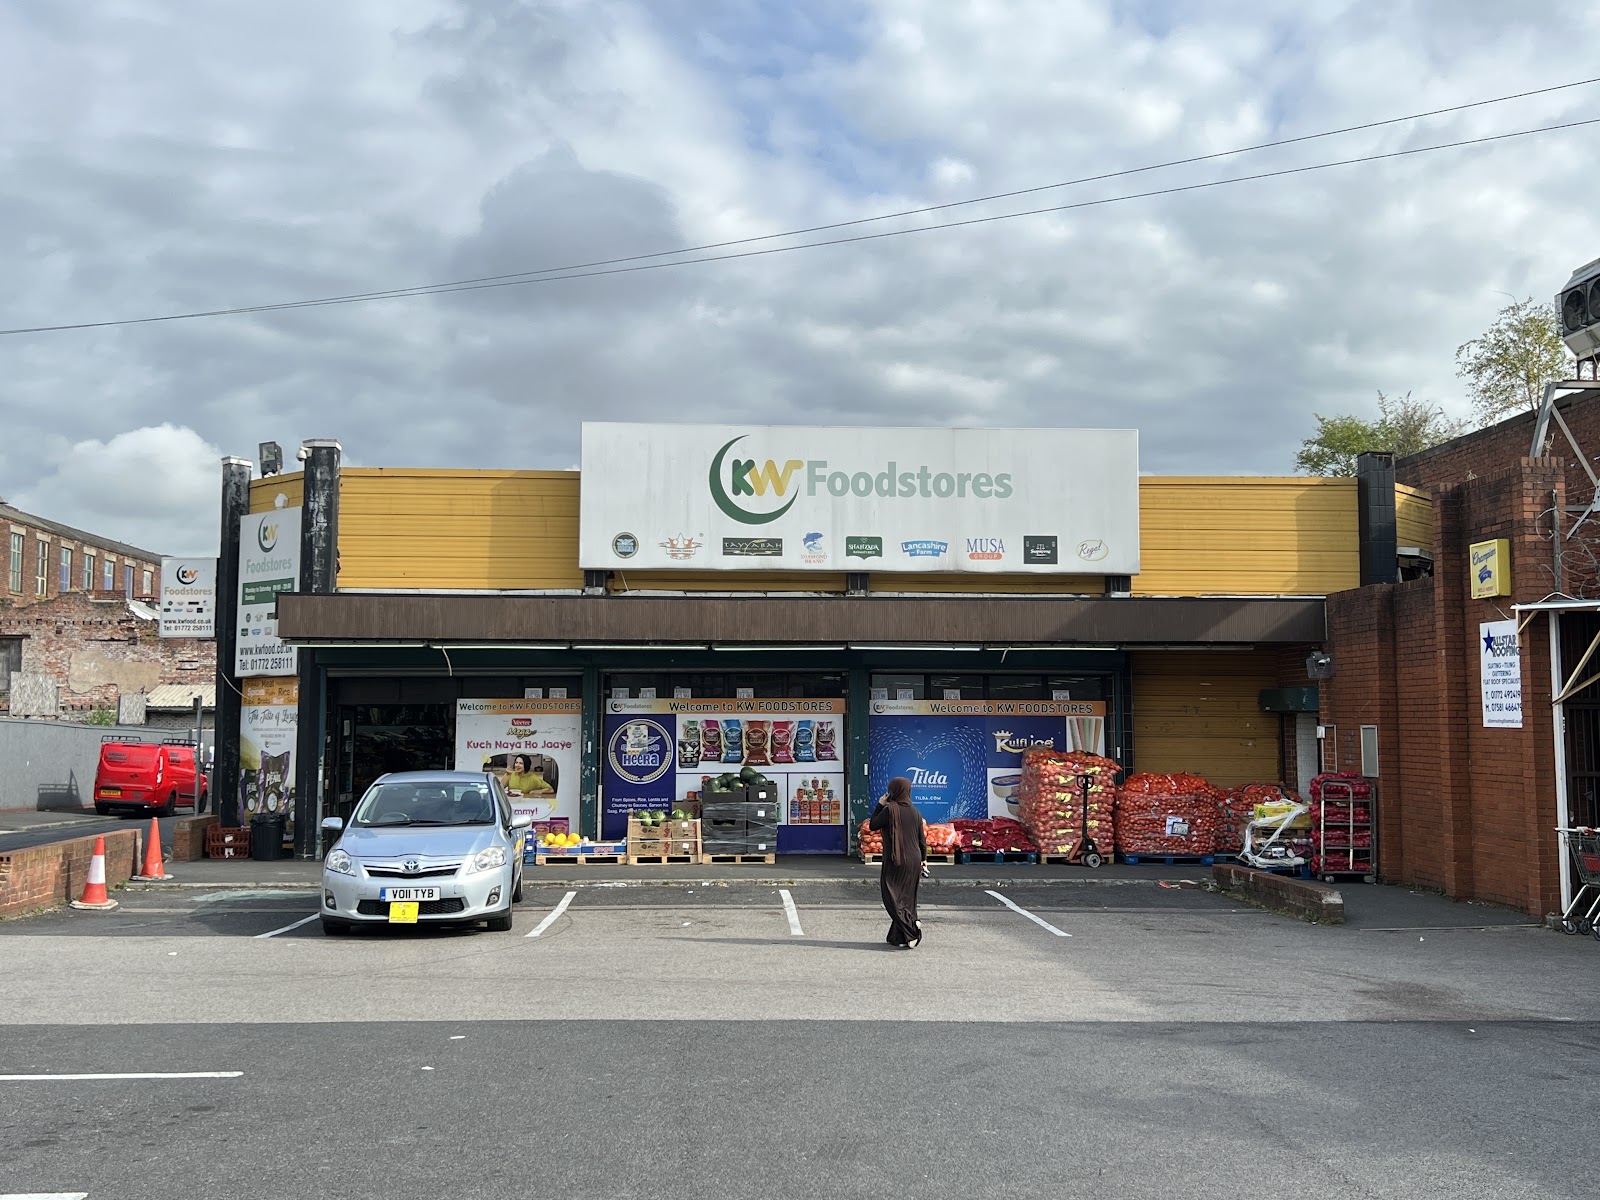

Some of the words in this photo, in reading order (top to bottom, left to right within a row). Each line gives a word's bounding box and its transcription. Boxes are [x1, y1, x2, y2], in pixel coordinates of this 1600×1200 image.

[732, 459, 804, 497] KW
[807, 461, 1013, 498] Foodstores
[263, 523, 279, 541] KW
[902, 541, 946, 551] Lancashire
[966, 538, 1005, 553] MUSA
[1079, 539, 1103, 558] Regal
[246, 557, 292, 574] Foodstores
[182, 569, 199, 579] KW
[164, 586, 213, 596] Foodstores
[1492, 634, 1517, 646] ALLSTAR
[240, 643, 293, 656] www.kwfood.co.uk
[1492, 646, 1521, 658] ROOFING
[239, 659, 249, 670] Tel:
[250, 658, 269, 670] 01772
[270, 657, 293, 670] 258111
[278, 688, 290, 696] Rice
[1491, 691, 1503, 699] 01772
[509, 702, 522, 710] KW
[526, 702, 580, 710] FOODSTORES
[669, 702, 719, 711] Welcome
[722, 702, 733, 711] to
[736, 702, 754, 711] KW
[758, 702, 832, 711] FOODSTORES
[930, 704, 980, 713] Welcome
[983, 704, 994, 712] to
[997, 704, 1015, 713] KW
[1018, 704, 1093, 714] FOODSTORES
[466, 740, 492, 749] Kuch
[495, 740, 521, 750] Naya
[525, 740, 538, 749] Ho
[542, 740, 572, 750] Jaaye
[996, 738, 1027, 752] Kulfi
[906, 766, 948, 784] Tilda
[414, 889, 434, 898] TYB
